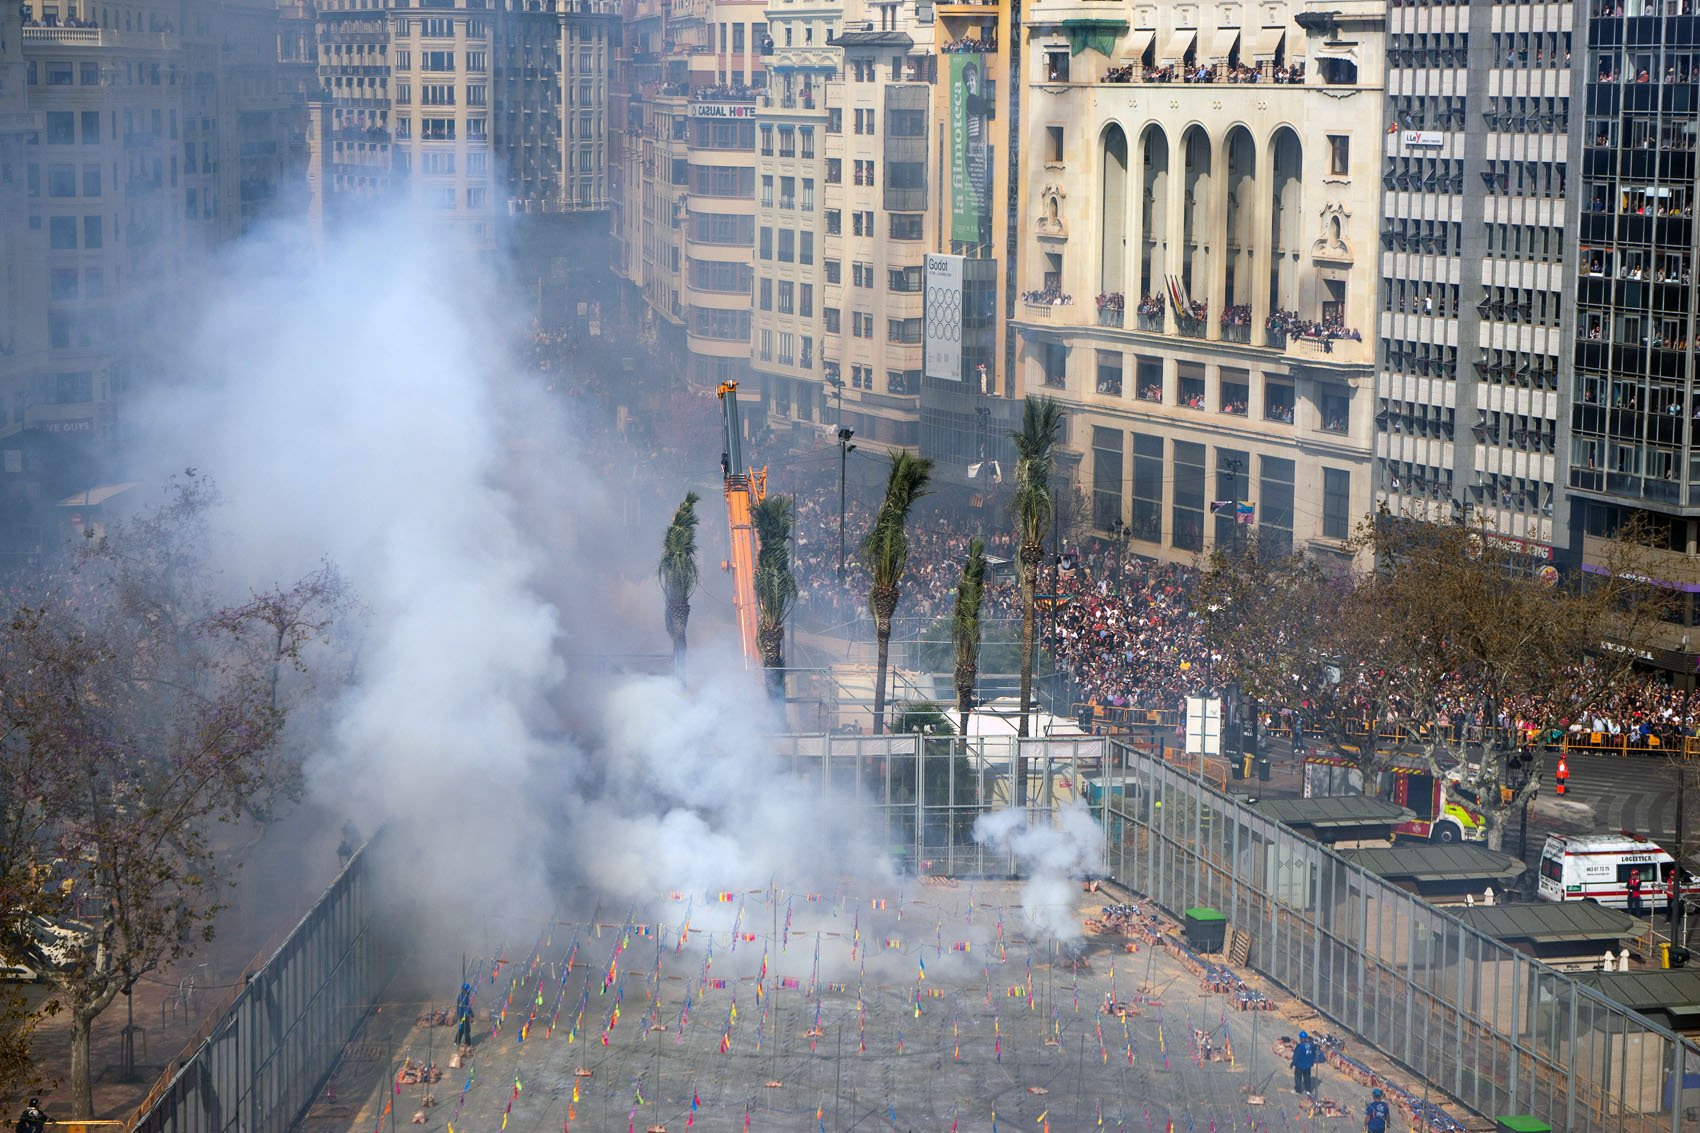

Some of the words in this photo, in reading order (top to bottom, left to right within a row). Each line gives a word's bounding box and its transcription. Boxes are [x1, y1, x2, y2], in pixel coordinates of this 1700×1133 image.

[698, 105, 726, 116] CASUAL
[729, 106, 756, 116] HOTE
[953, 81, 963, 190] filmoteca
[954, 196, 964, 215] la
[929, 258, 948, 271] Godot
[63, 422, 89, 432] GUYS
